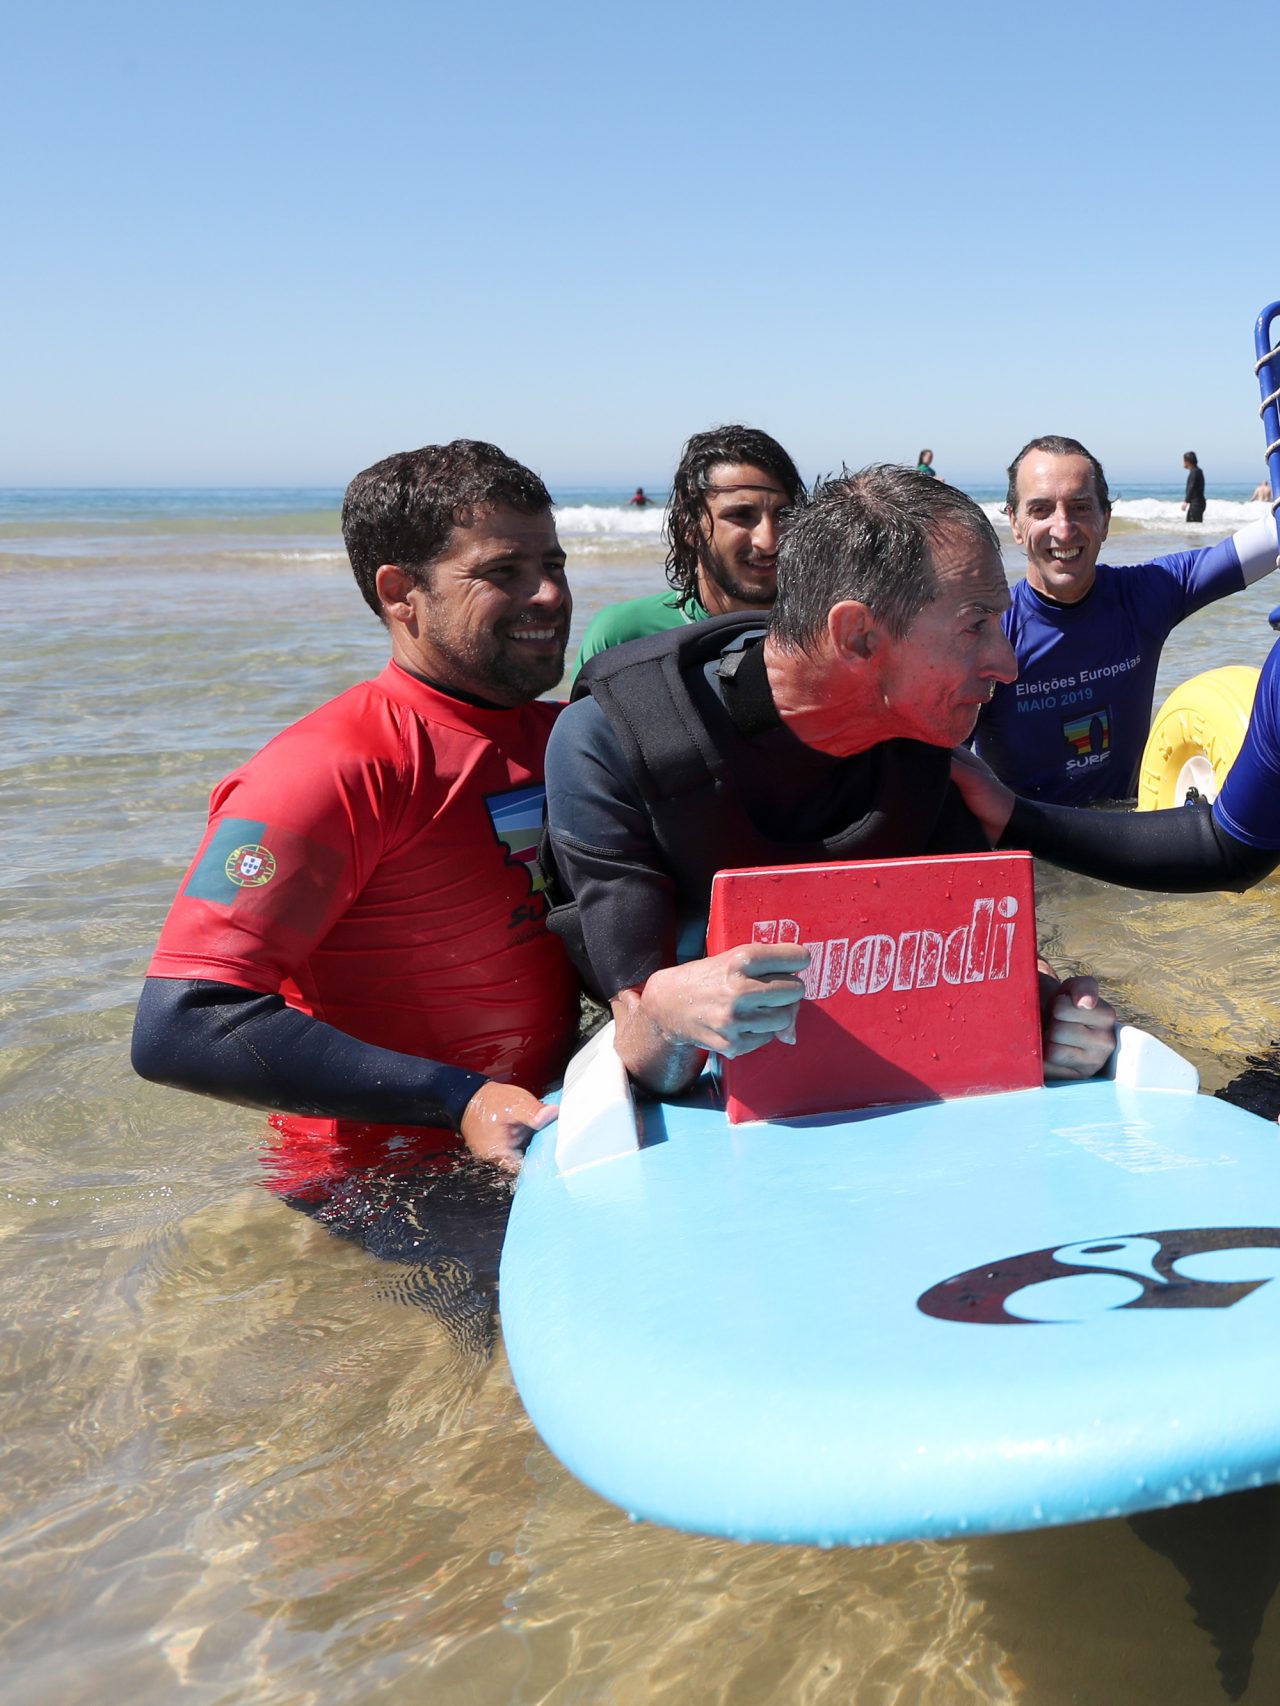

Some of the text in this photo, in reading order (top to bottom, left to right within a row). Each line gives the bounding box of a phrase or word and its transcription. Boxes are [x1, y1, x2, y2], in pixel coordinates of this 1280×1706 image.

[1016, 655, 1141, 696] Eleições Europeias
[1017, 688, 1093, 713] MAIO 2019
[1065, 751, 1111, 770] SURF
[752, 896, 1019, 1001] uondi
